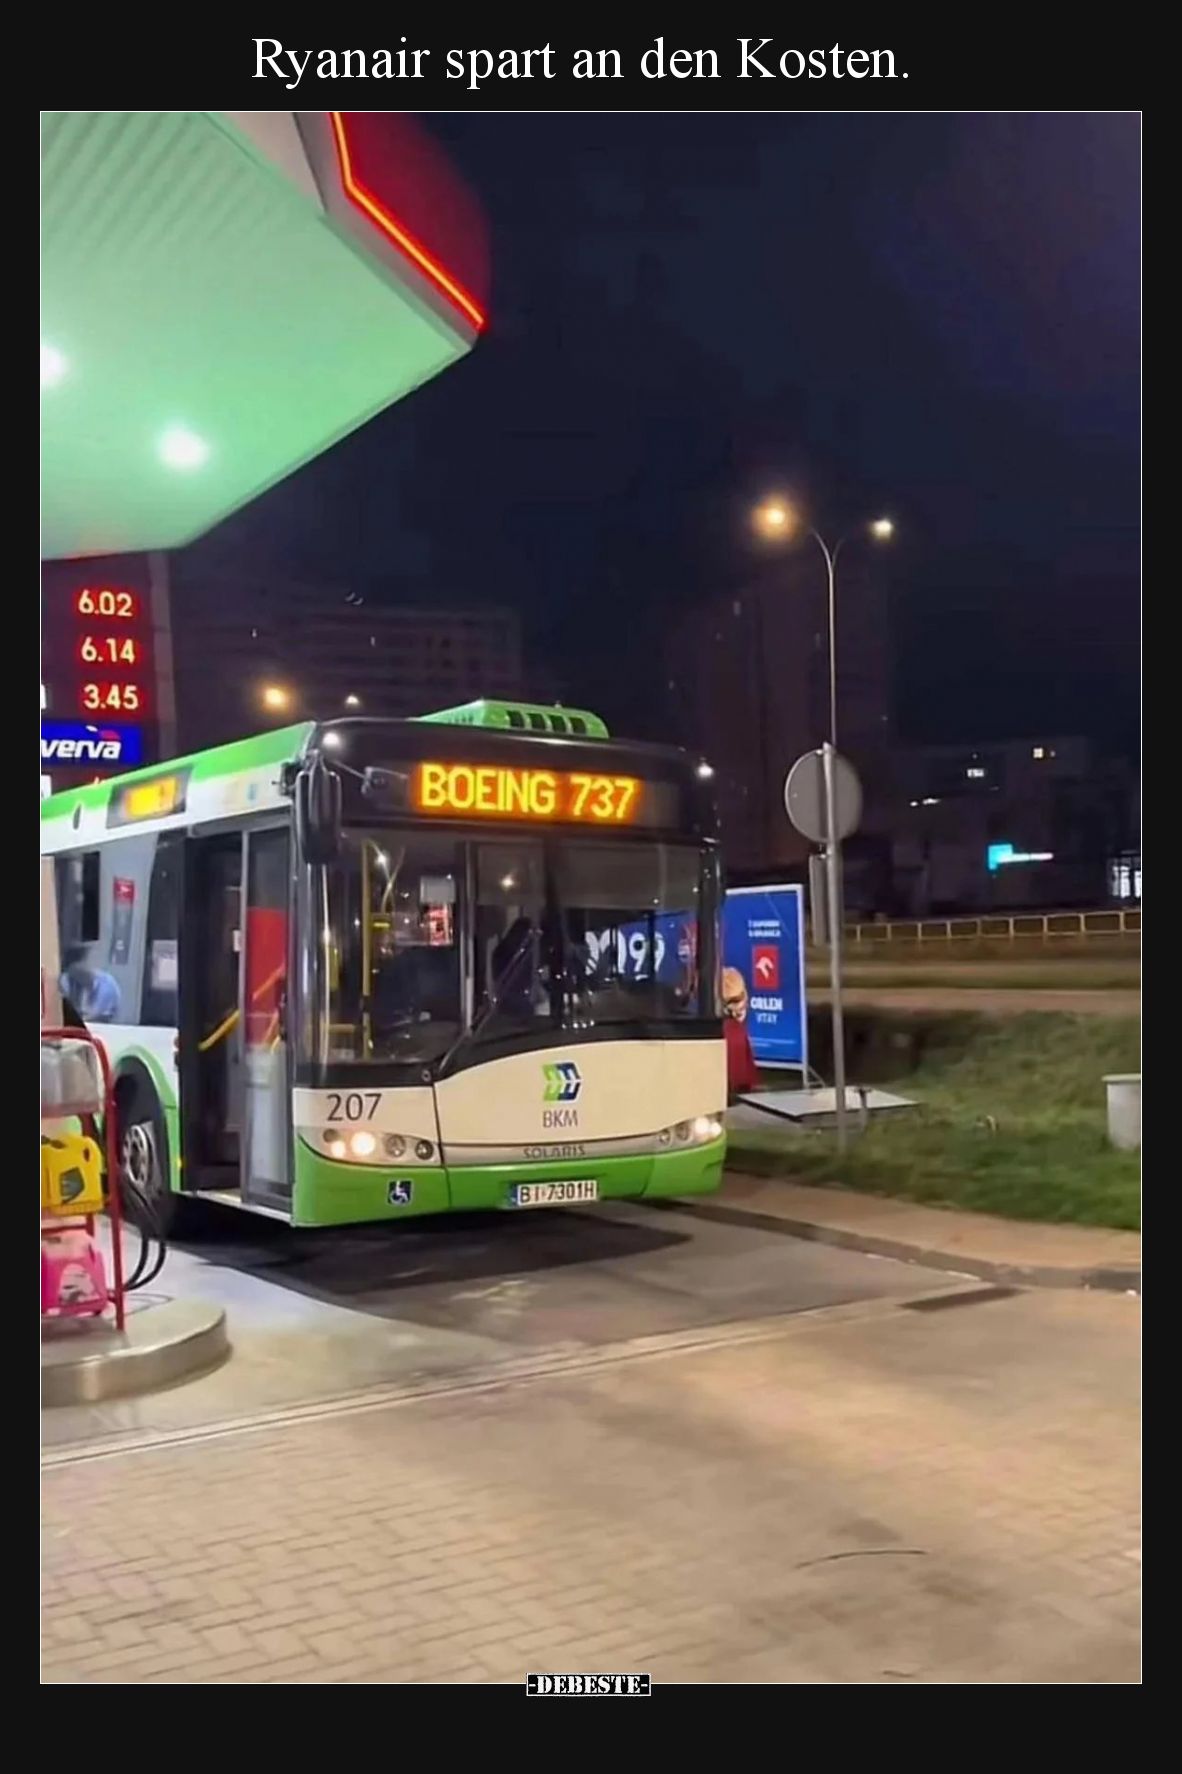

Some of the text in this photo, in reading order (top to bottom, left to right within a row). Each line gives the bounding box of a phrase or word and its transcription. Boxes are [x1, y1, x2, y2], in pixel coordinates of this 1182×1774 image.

[78, 589, 133, 617] 6.02
[81, 637, 136, 664] 6.14
[84, 683, 139, 710] 3.45
[41, 738, 121, 759] verva
[420, 763, 636, 819] BOEING 737
[750, 996, 783, 1011] ORLEN
[326, 1093, 383, 1121] 207
[542, 1109, 579, 1129] BKM
[523, 1144, 587, 1159] SOLARIS
